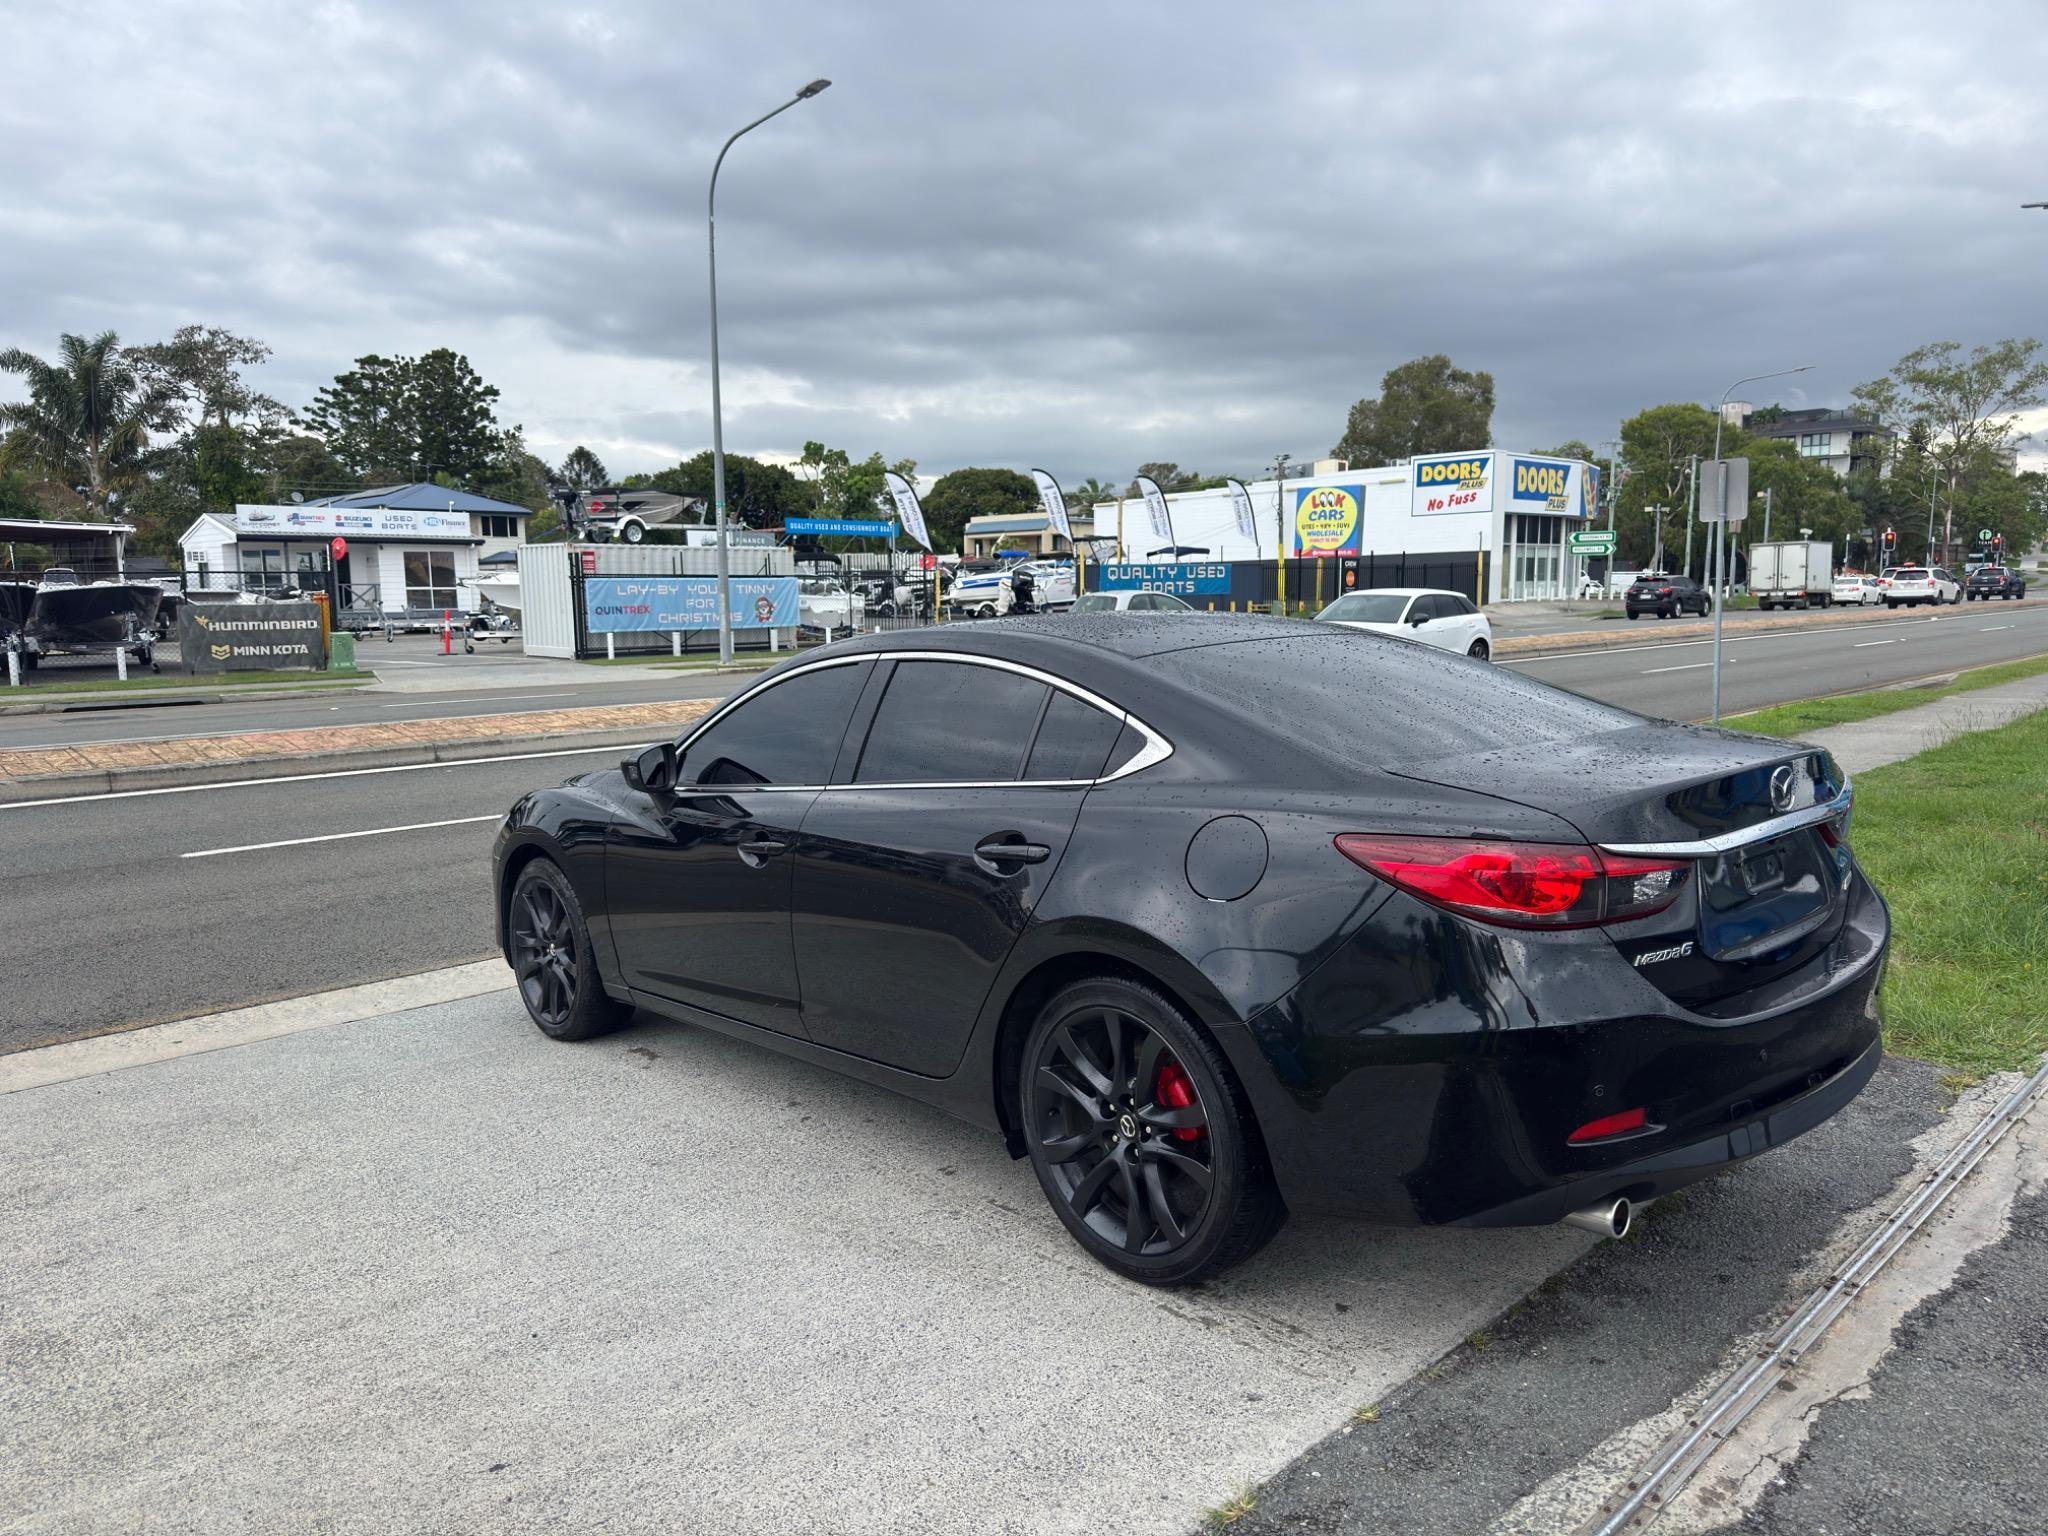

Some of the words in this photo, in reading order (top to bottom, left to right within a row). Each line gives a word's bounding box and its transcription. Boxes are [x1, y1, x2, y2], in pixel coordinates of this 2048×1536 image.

[1421, 461, 1481, 483] DOORS
[1460, 480, 1484, 488] PLUS
[1517, 464, 1564, 495] DOORS
[1311, 491, 1346, 509] LOOK
[1427, 499, 1444, 511] No
[1448, 492, 1477, 507] Fuss
[1547, 498, 1566, 510] PLUS
[1308, 509, 1345, 521] CARS
[790, 522, 813, 530] QUALITY
[735, 537, 765, 545] FNANCE
[1107, 566, 1177, 581] QUALITY
[1186, 566, 1225, 578] USED
[617, 585, 679, 595] LAY-BY
[687, 584, 719, 595] YOU
[736, 584, 776, 594] TINNY
[1142, 581, 1195, 593] BOATS
[686, 599, 715, 609] FOR
[595, 605, 650, 616] QUINTREX
[658, 612, 743, 624] CHRISTMS
[208, 620, 318, 631] HUMMINBIRD
[233, 645, 271, 656] MINN
[273, 644, 309, 655] KOTA
